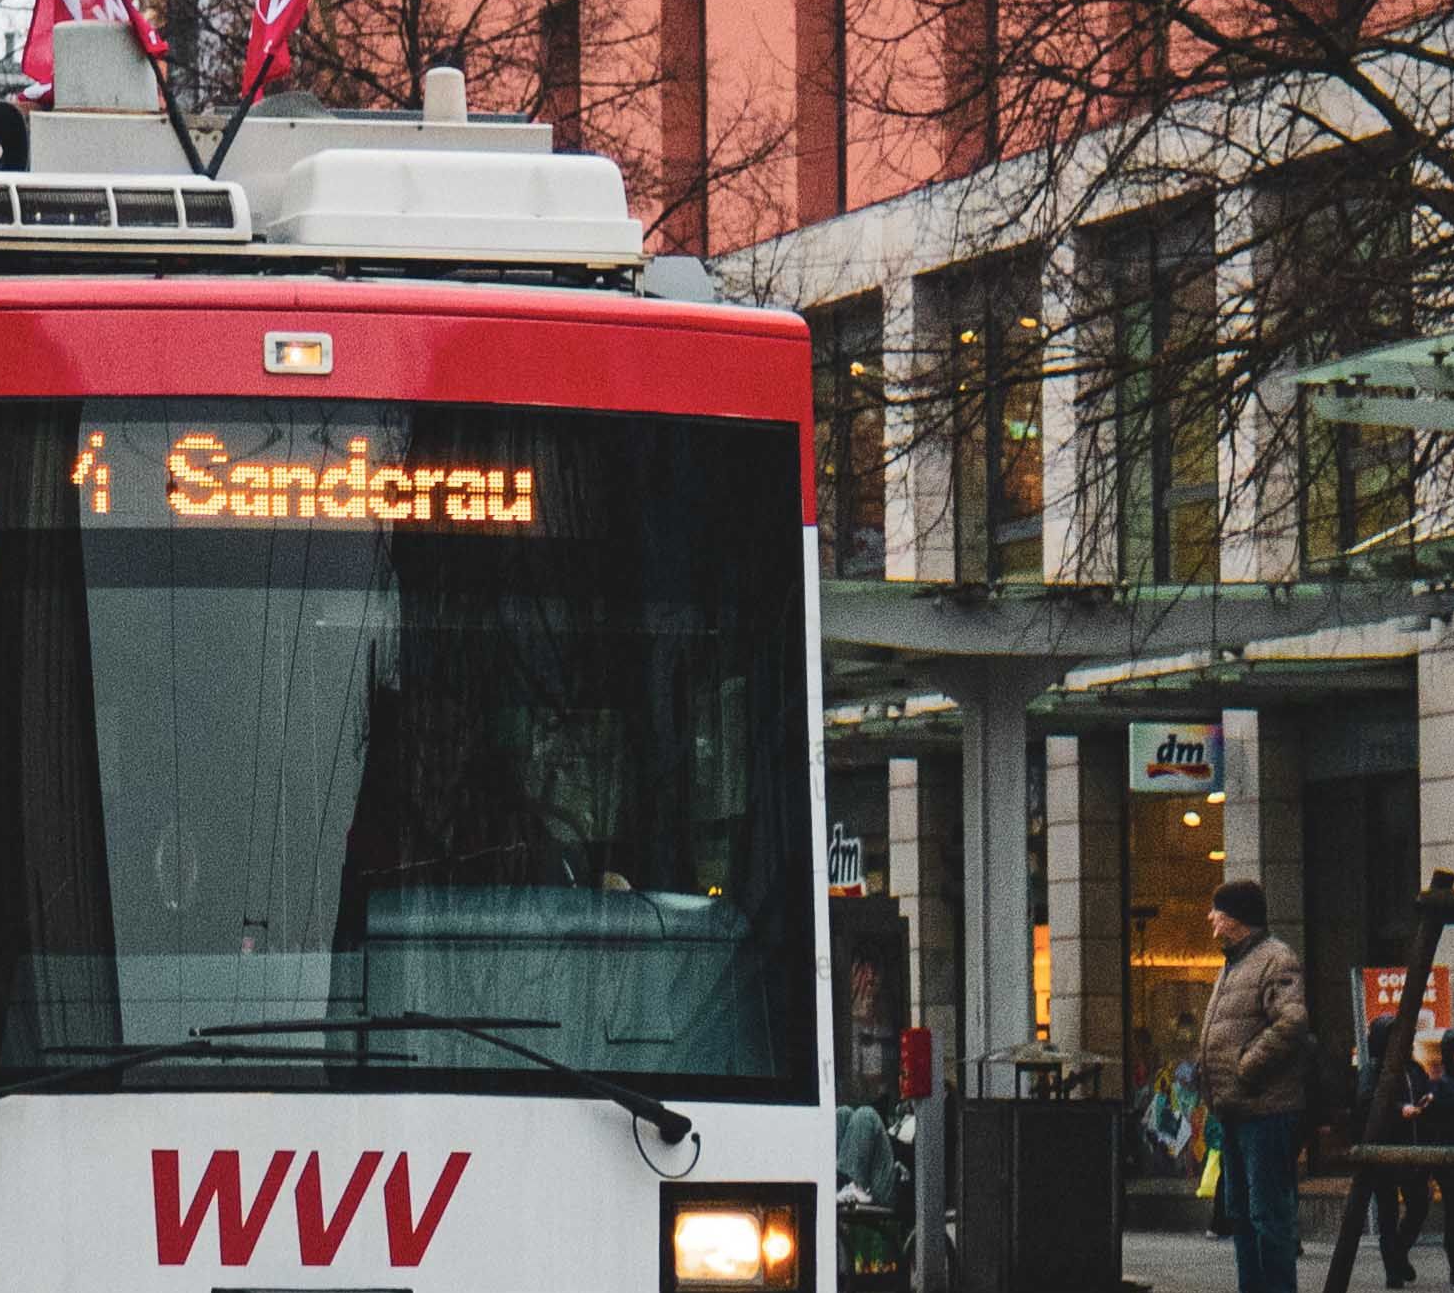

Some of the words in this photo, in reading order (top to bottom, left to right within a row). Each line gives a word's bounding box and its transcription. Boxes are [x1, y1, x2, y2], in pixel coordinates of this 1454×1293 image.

[1155, 732, 1207, 767] dm
[828, 824, 861, 883] dm
[150, 1147, 473, 1268] WVV
